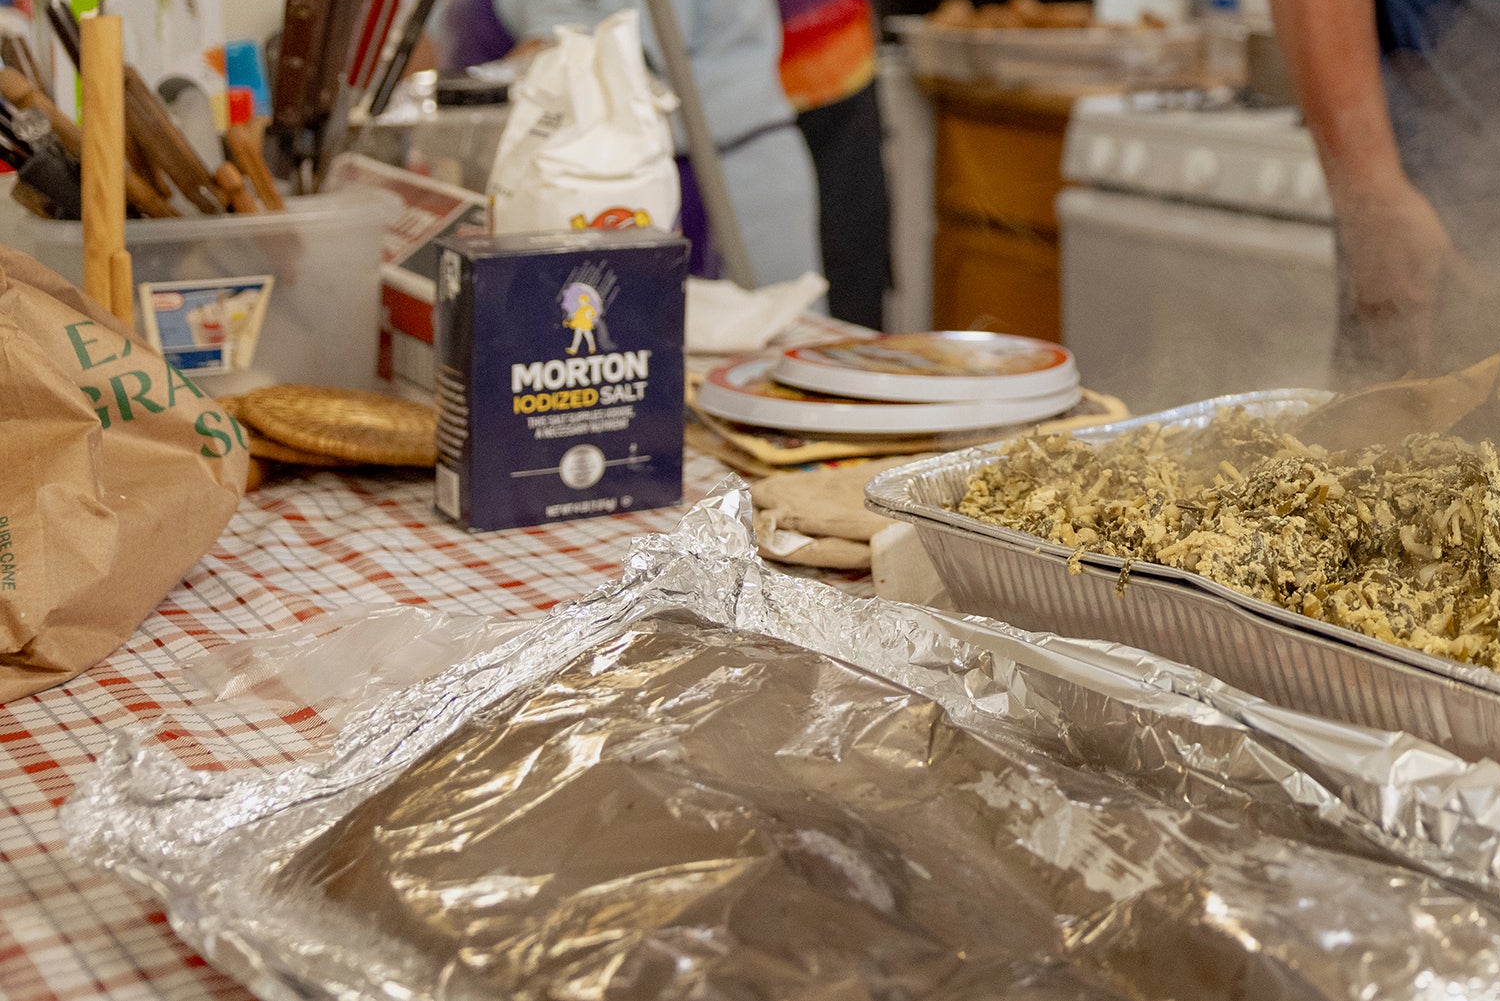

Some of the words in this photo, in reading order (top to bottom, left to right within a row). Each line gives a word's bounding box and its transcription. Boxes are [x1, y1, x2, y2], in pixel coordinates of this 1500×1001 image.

[511, 349, 649, 393] MORTON
[513, 388, 599, 415] IODIZED
[600, 381, 648, 405] SALT
[0, 553, 17, 591] CANE
